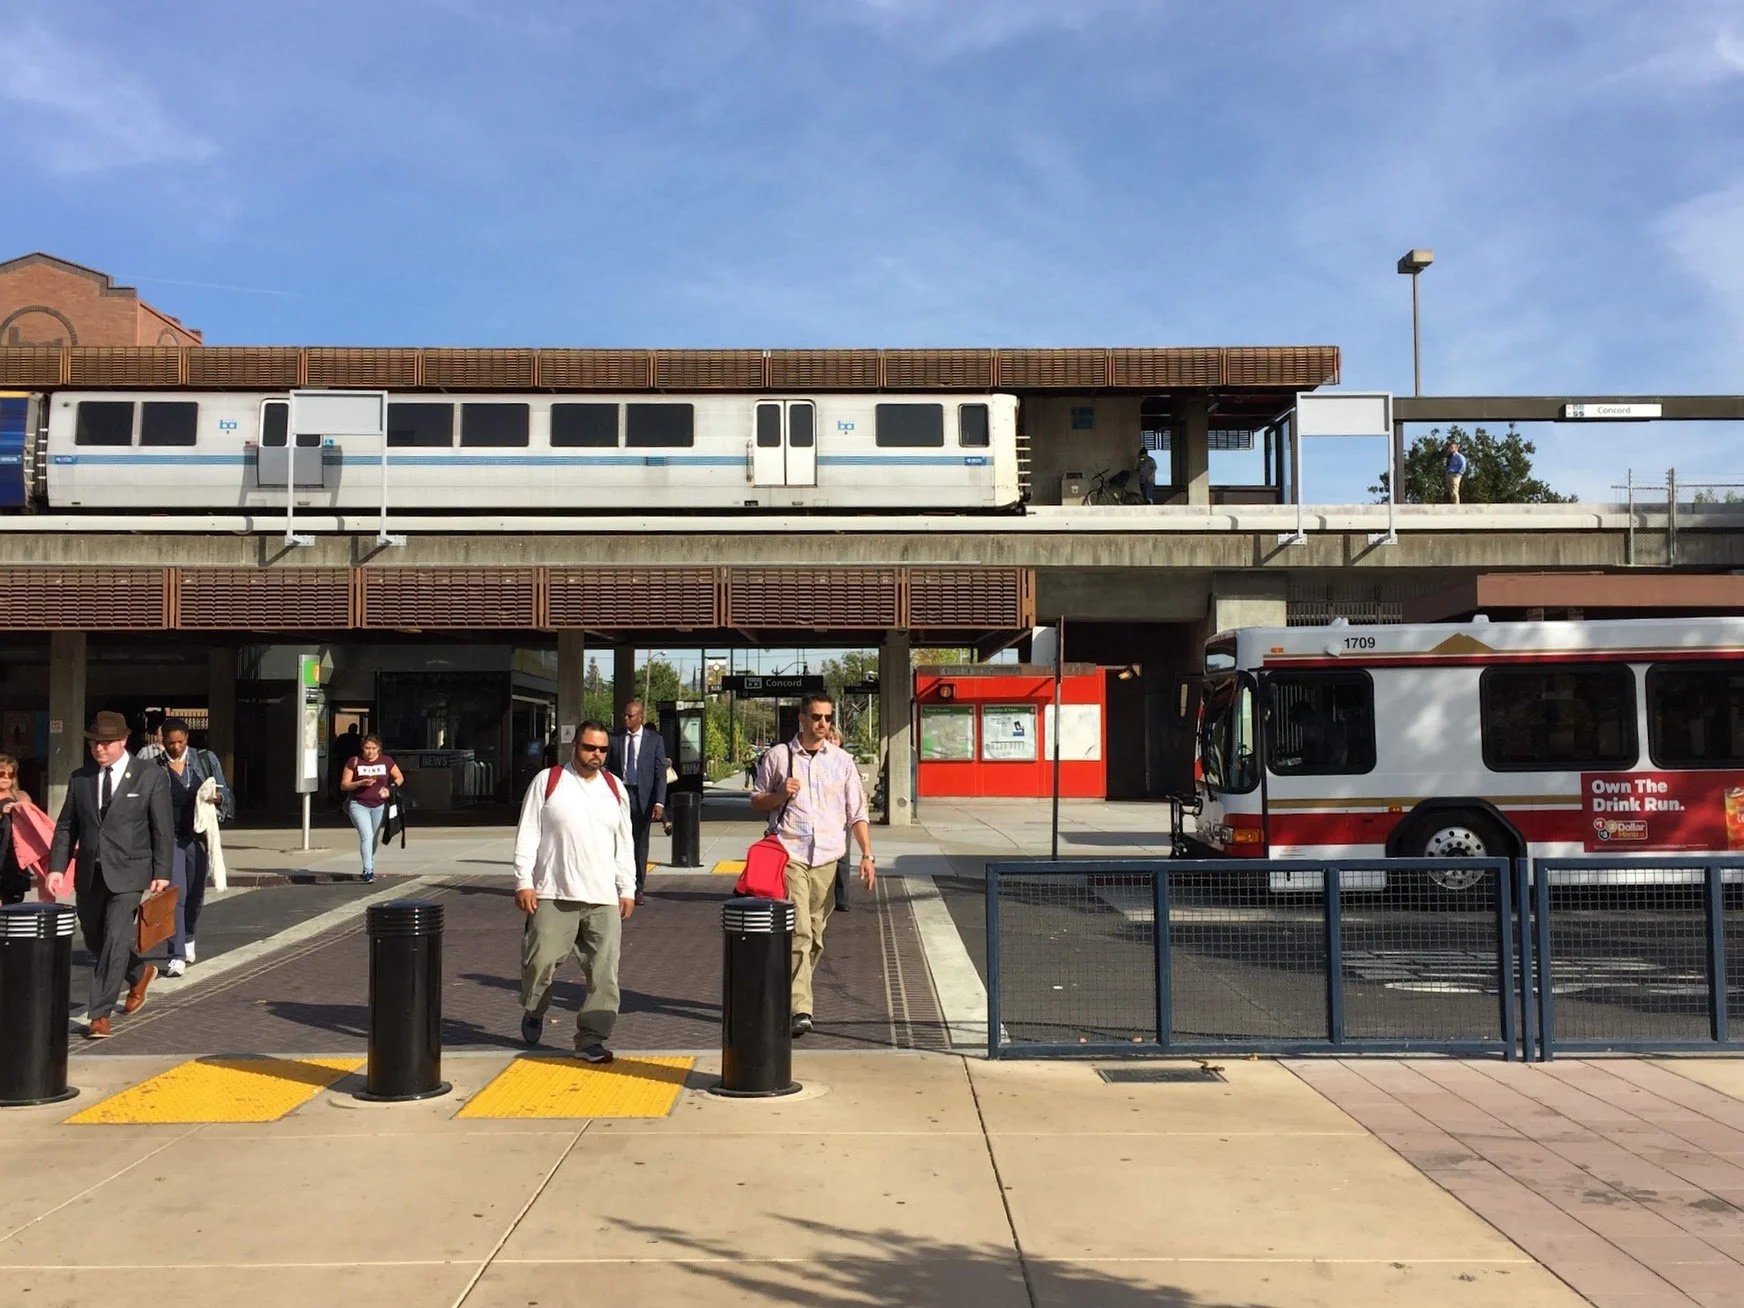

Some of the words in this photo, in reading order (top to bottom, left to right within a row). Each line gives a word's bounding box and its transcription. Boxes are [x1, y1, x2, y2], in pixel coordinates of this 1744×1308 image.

[1597, 406, 1631, 414] Concord
[1344, 636, 1376, 649] 1709
[766, 678, 802, 688] Concord
[422, 755, 448, 766] NEWS
[1592, 780, 1631, 793] Own
[1635, 778, 1668, 793] The
[1593, 797, 1640, 811] Drink
[1644, 798, 1686, 811] Run.
[1617, 822, 1645, 832] Dollar
